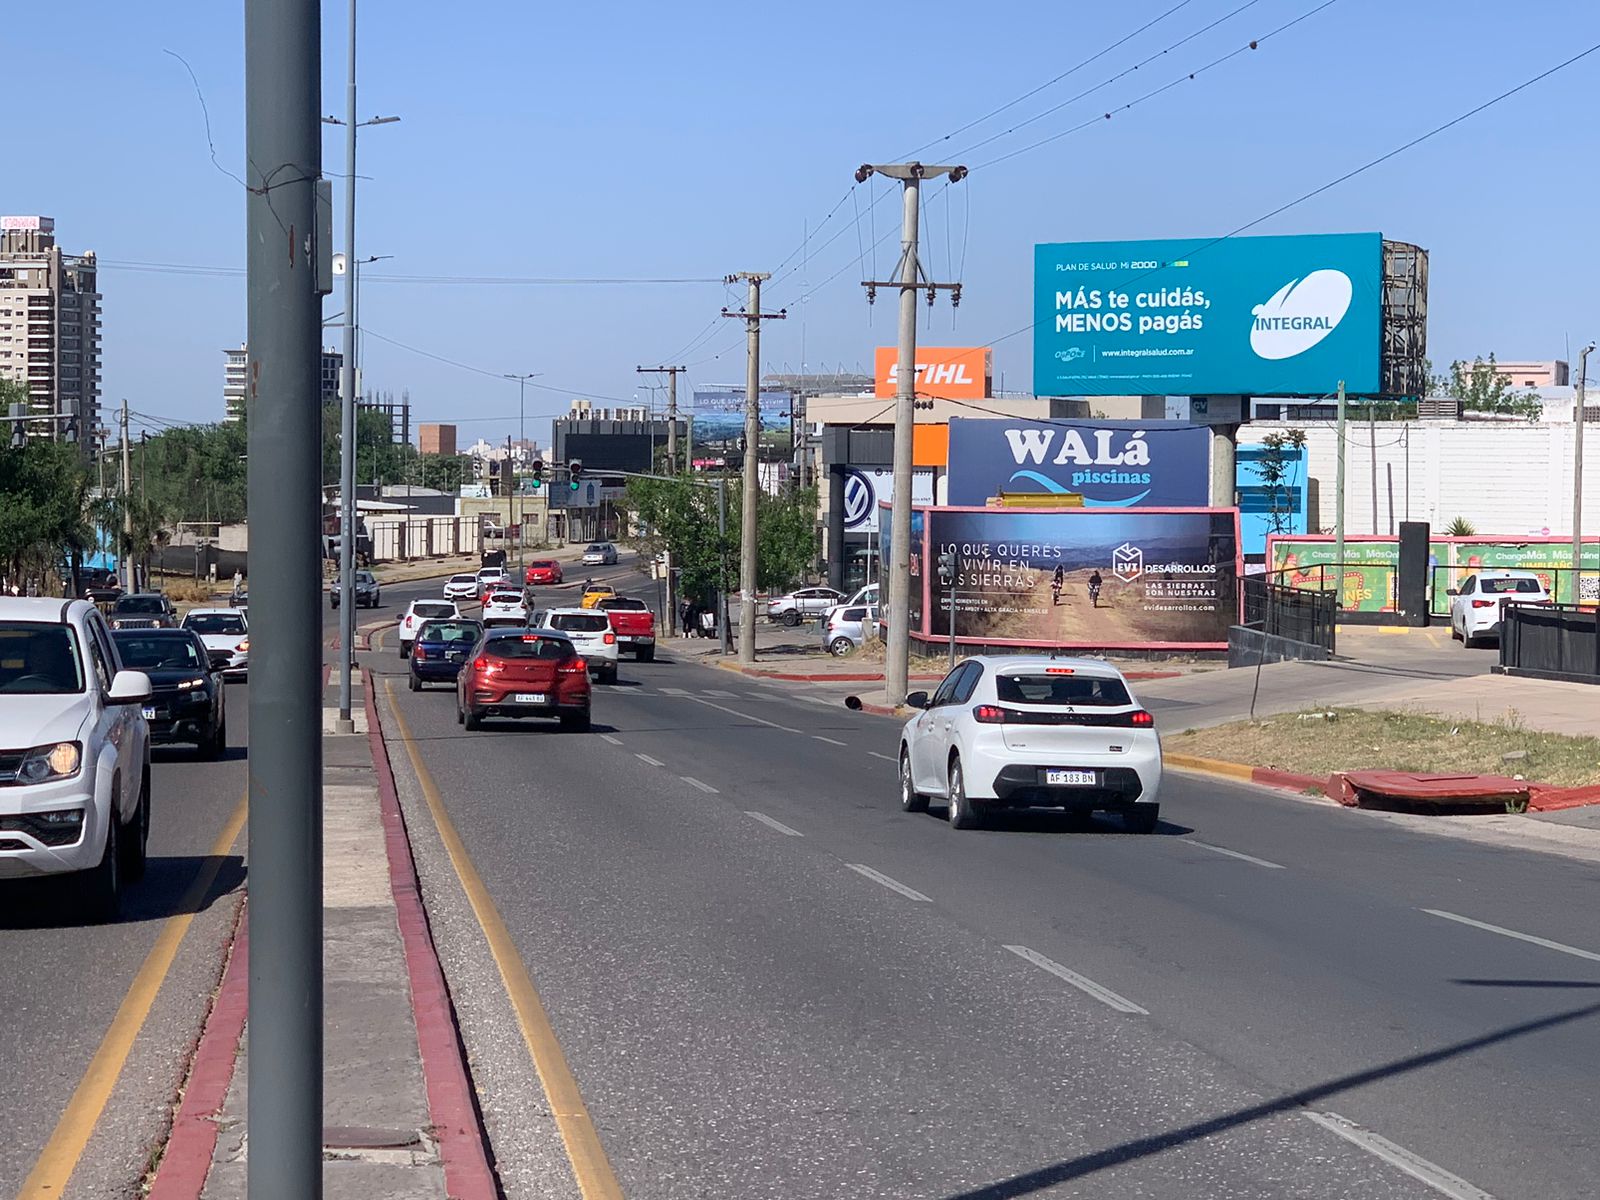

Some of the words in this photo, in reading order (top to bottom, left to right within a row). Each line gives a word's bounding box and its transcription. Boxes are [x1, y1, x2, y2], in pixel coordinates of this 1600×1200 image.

[1056, 263, 1076, 271] PLAN
[1078, 263, 1089, 271] DE
[1091, 262, 1117, 270] SALUD
[1131, 261, 1157, 269] 2000
[1056, 285, 1102, 310] MÁS
[1108, 290, 1129, 308] te
[1135, 286, 1210, 309] cuidás,
[1056, 312, 1132, 332] MENOS
[1139, 310, 1203, 334] pagás
[1255, 316, 1333, 331] INTEGRAL
[1101, 348, 1194, 357] www.integralsalud.com.ar
[1004, 429, 1151, 466] WALá
[1072, 468, 1151, 486] piscinas
[941, 543, 957, 555] LO
[962, 543, 990, 556] QUE
[997, 542, 1061, 558] QUERÉS
[962, 559, 1001, 571] VIVIR
[1009, 560, 1029, 572] EN
[1117, 563, 1138, 572] EVI
[1145, 564, 1216, 574] DESARROLLOS
[970, 574, 1035, 588] SIERRAS
[1050, 773, 1060, 782] AF
[1063, 773, 1080, 783] 183
[1082, 774, 1094, 783] BN
